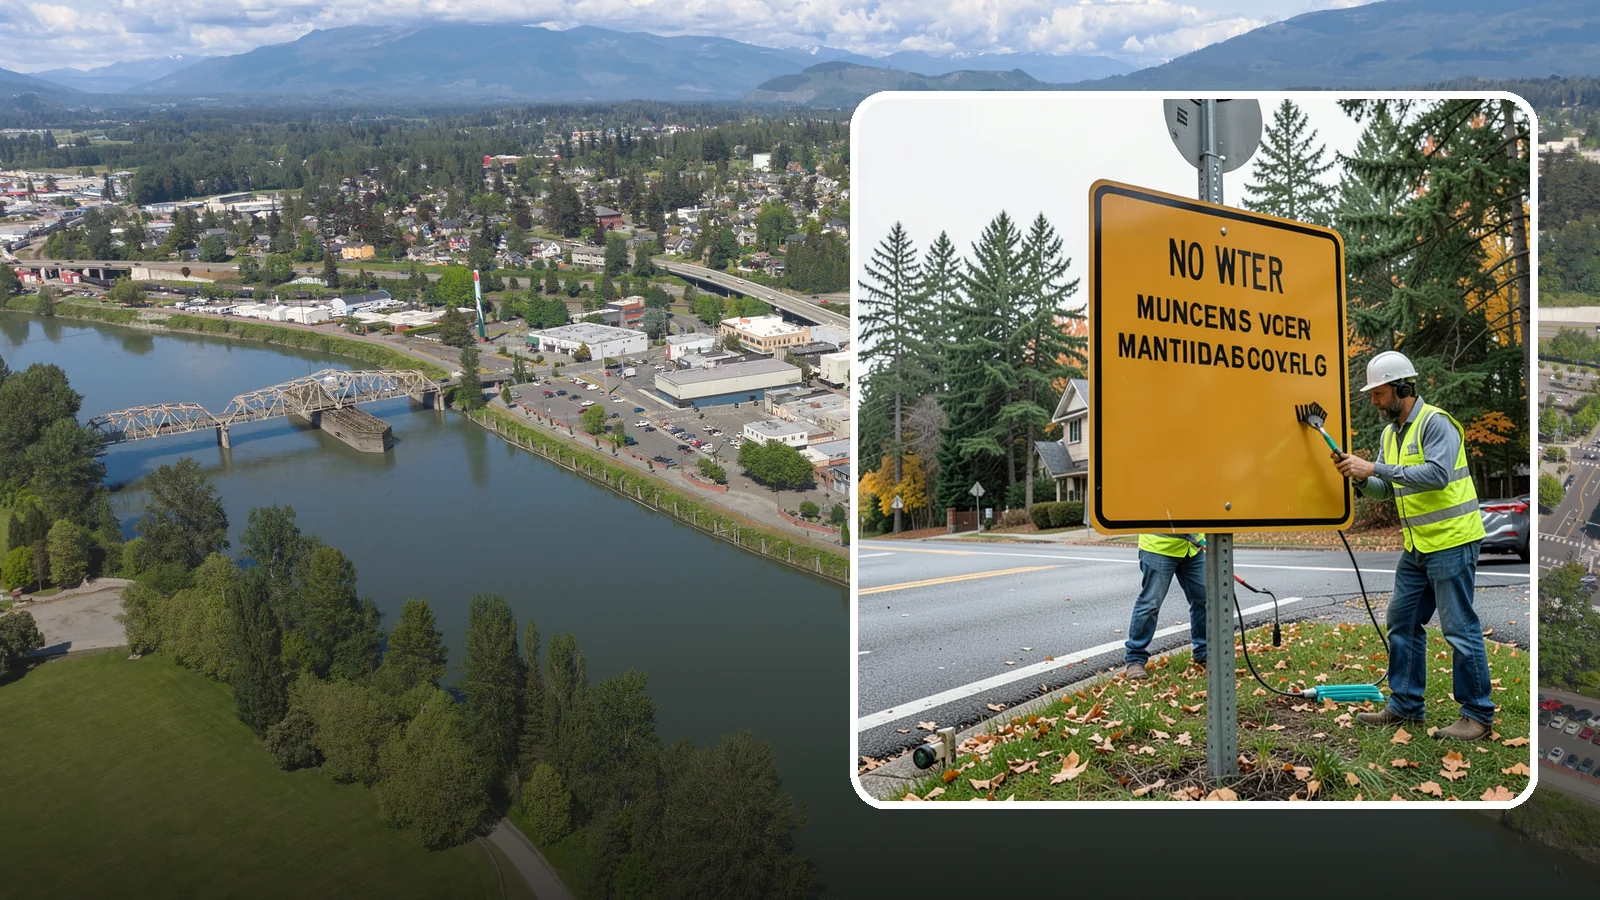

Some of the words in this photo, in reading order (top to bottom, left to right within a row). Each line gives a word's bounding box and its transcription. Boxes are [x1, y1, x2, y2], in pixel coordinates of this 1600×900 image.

[1169, 237, 1204, 281] NO
[1215, 245, 1284, 294] WTER
[1137, 293, 1252, 333] MUNCENS
